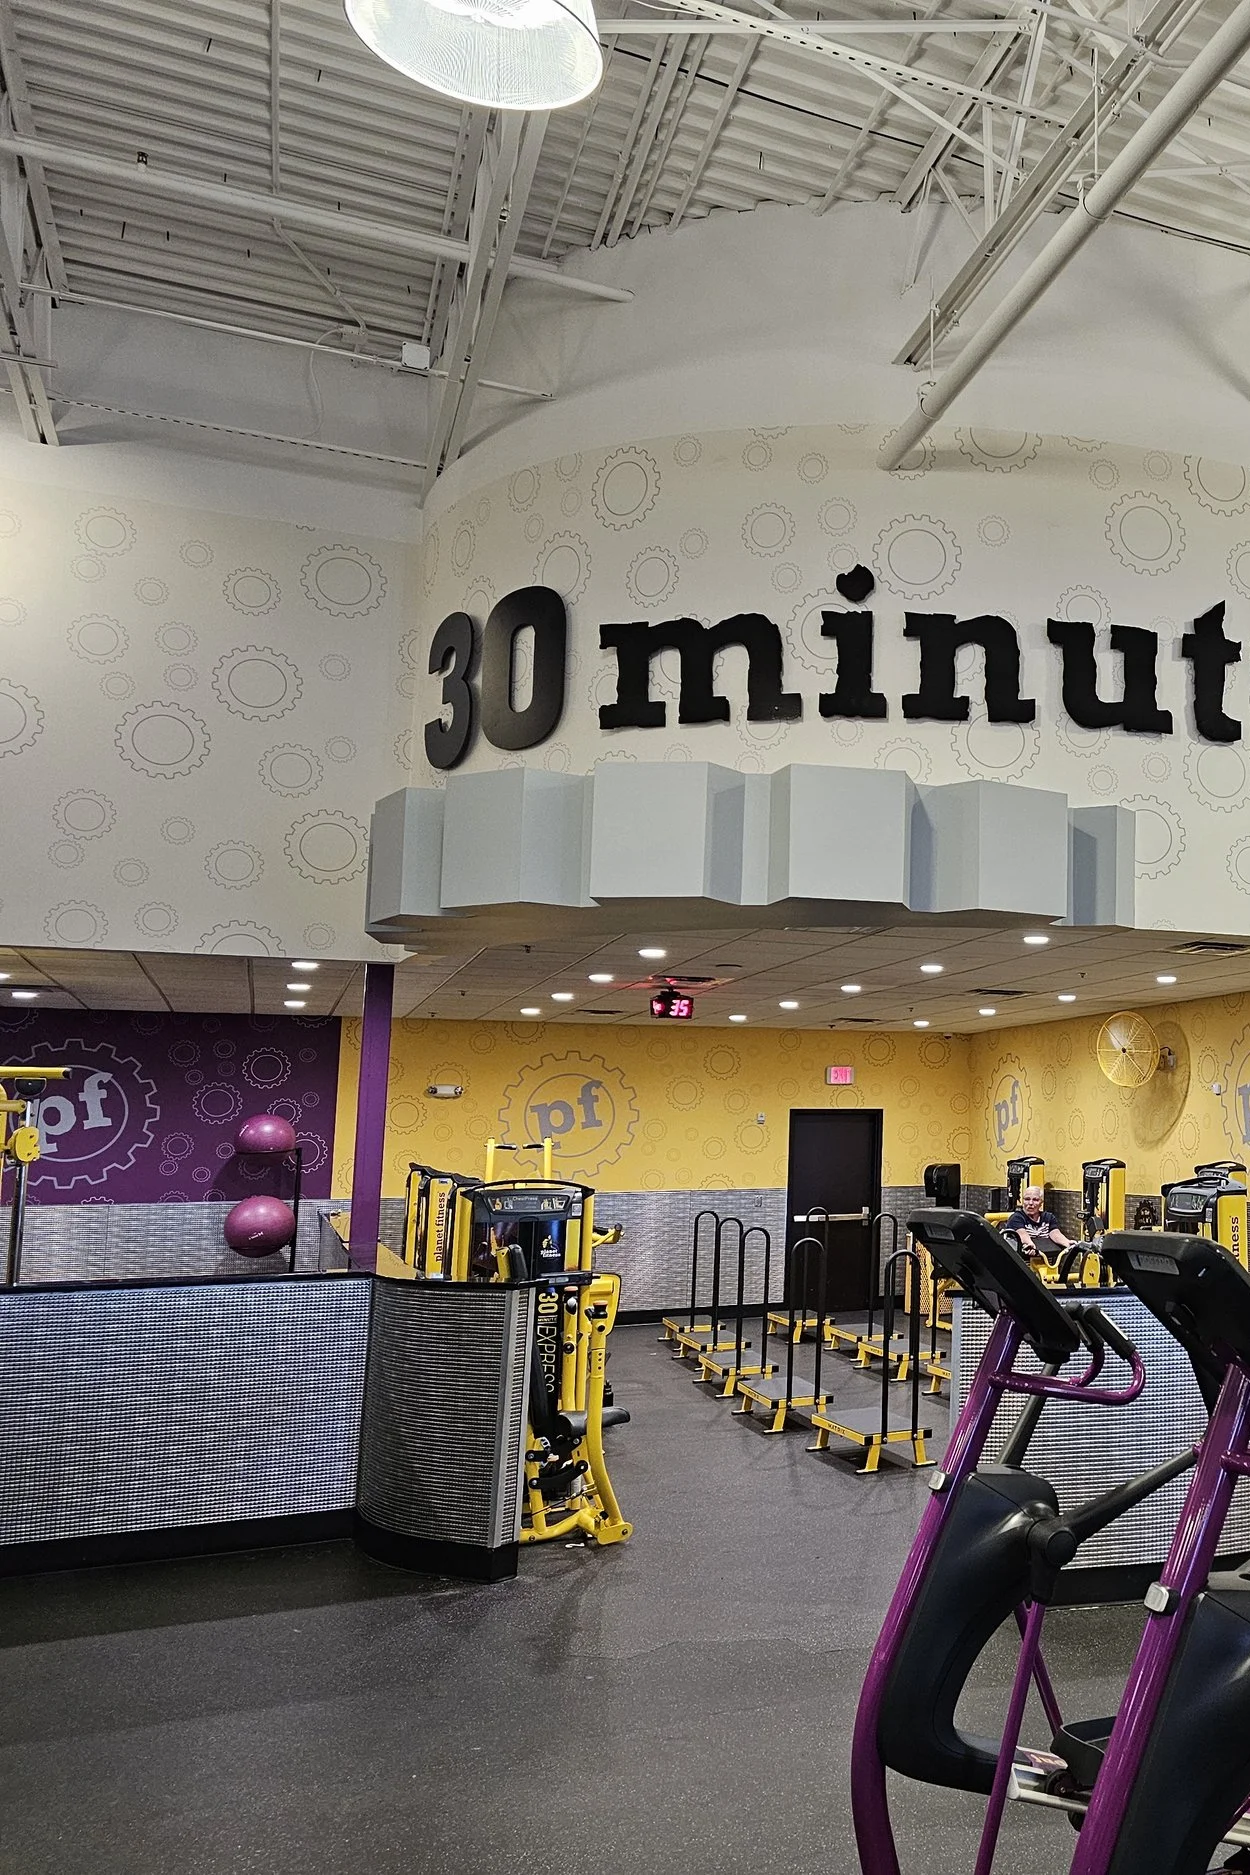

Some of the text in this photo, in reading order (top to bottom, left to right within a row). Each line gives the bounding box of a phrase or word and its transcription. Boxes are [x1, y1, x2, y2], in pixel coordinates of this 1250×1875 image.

[424, 585, 567, 770] 30
[669, 999, 690, 1017] 35
[37, 1067, 113, 1155] pf
[529, 1080, 604, 1153] pf
[994, 1080, 1019, 1148] pf
[435, 1192, 446, 1227] fitness
[434, 1229, 444, 1263] planet
[1231, 1216, 1240, 1258] ness
[538, 1292, 559, 1314] 30
